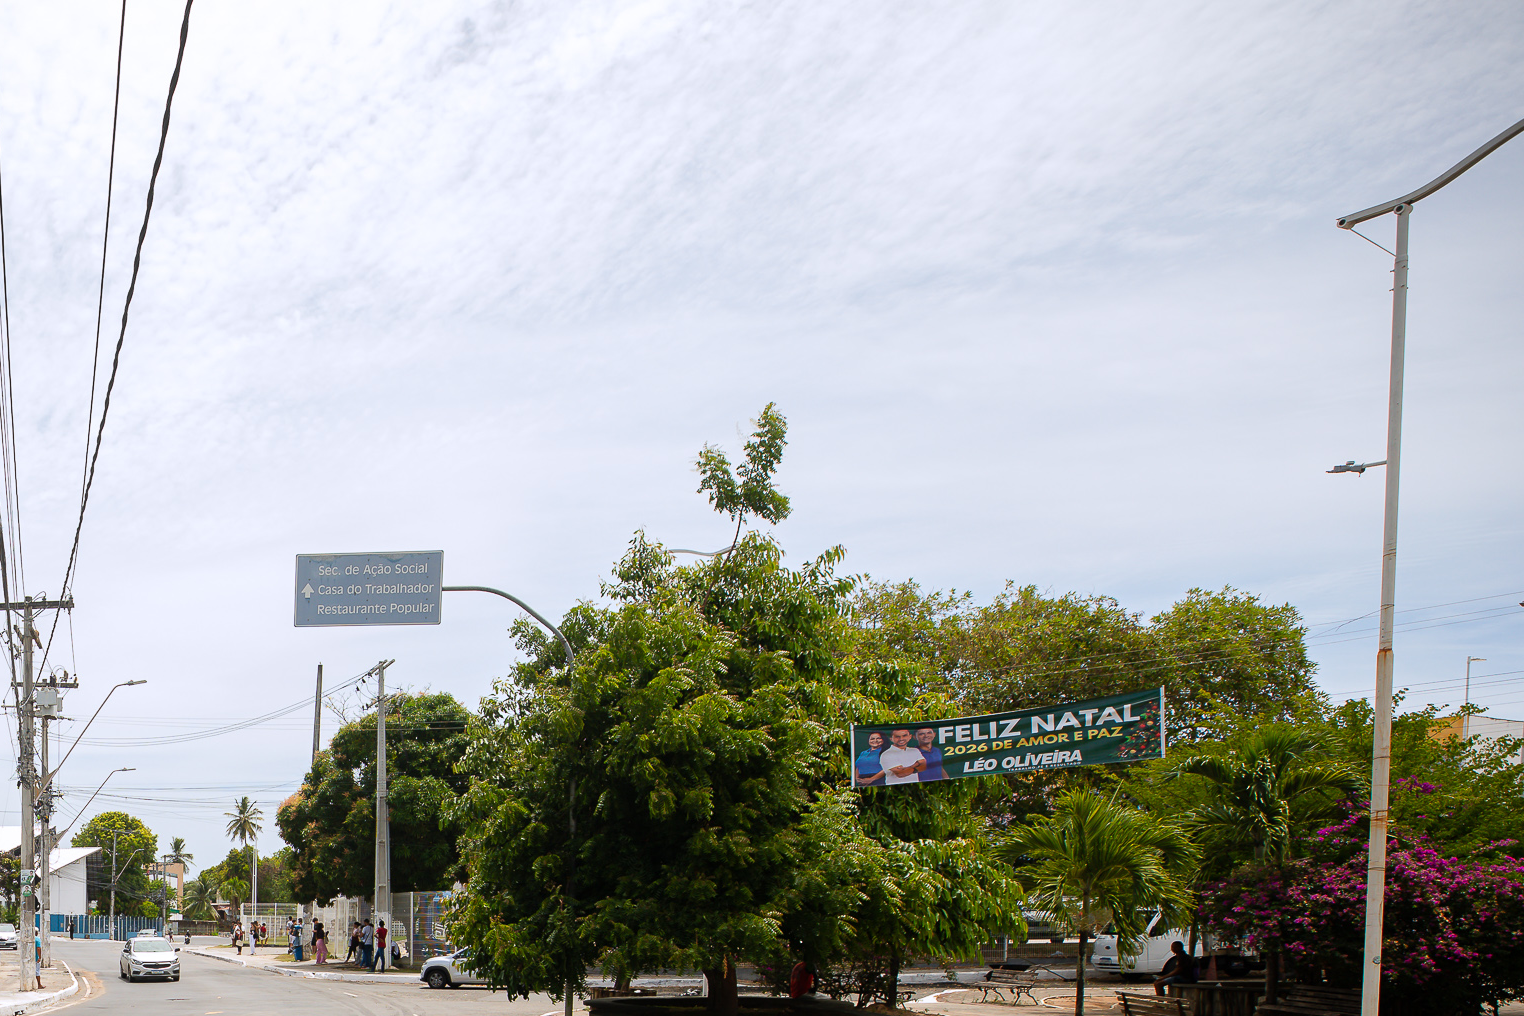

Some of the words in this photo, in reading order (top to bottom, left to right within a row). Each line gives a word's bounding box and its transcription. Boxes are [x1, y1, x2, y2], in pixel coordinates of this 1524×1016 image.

[318, 565, 341, 576] Sec.
[345, 564, 360, 576] de
[363, 563, 392, 577] Ação
[394, 562, 428, 574] Social
[318, 584, 344, 595] Casa
[347, 584, 362, 595] do
[365, 583, 435, 594] Trabalhador
[317, 604, 387, 615] Restaurante
[390, 602, 435, 614] Popular
[938, 717, 1022, 745] FELIZ
[1030, 703, 1141, 734] NATAL
[943, 742, 988, 757] 2026
[992, 739, 1013, 751] DE
[1016, 732, 1070, 748] AMOR
[1073, 730, 1083, 741] E
[1087, 726, 1123, 740] PAZ
[963, 757, 998, 773] LÉO
